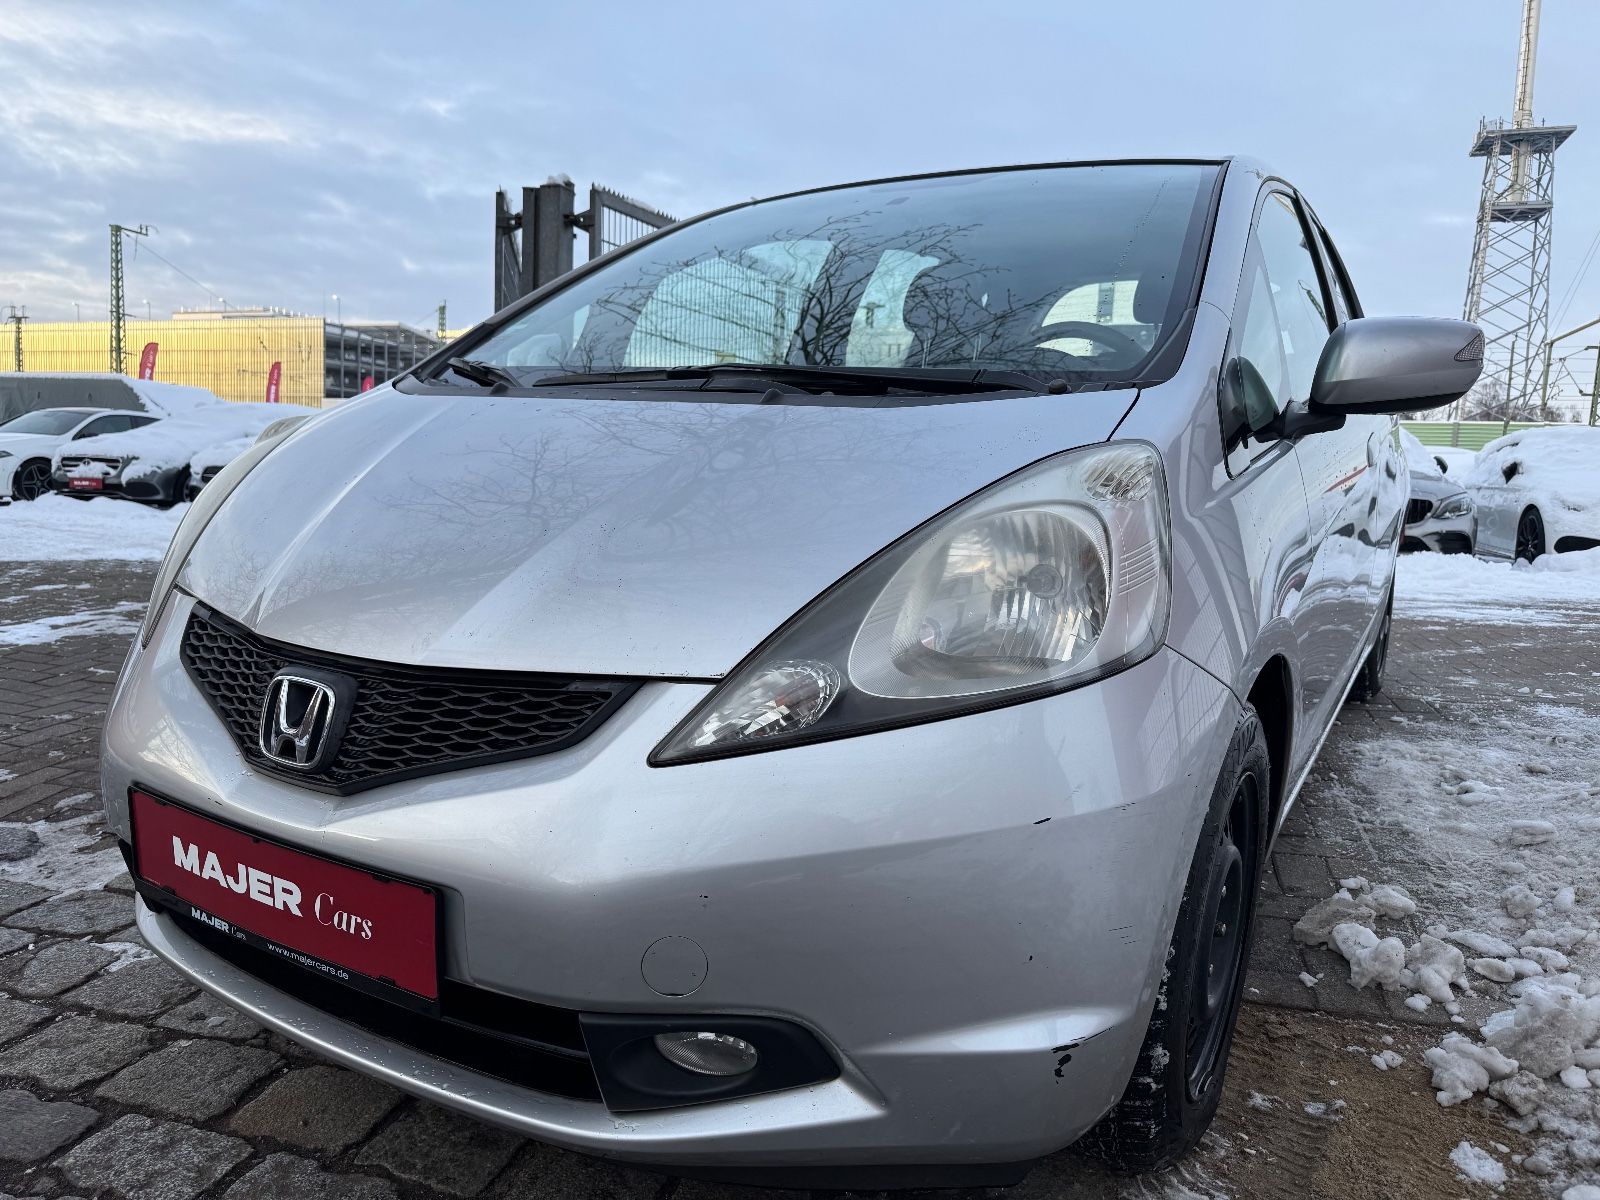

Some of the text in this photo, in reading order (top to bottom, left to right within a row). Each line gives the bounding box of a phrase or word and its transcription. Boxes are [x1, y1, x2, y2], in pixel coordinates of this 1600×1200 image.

[172, 835, 373, 940] MAJER Cars
[191, 906, 247, 941] MAJER Cars
[267, 942, 349, 980] www.majercars.de
